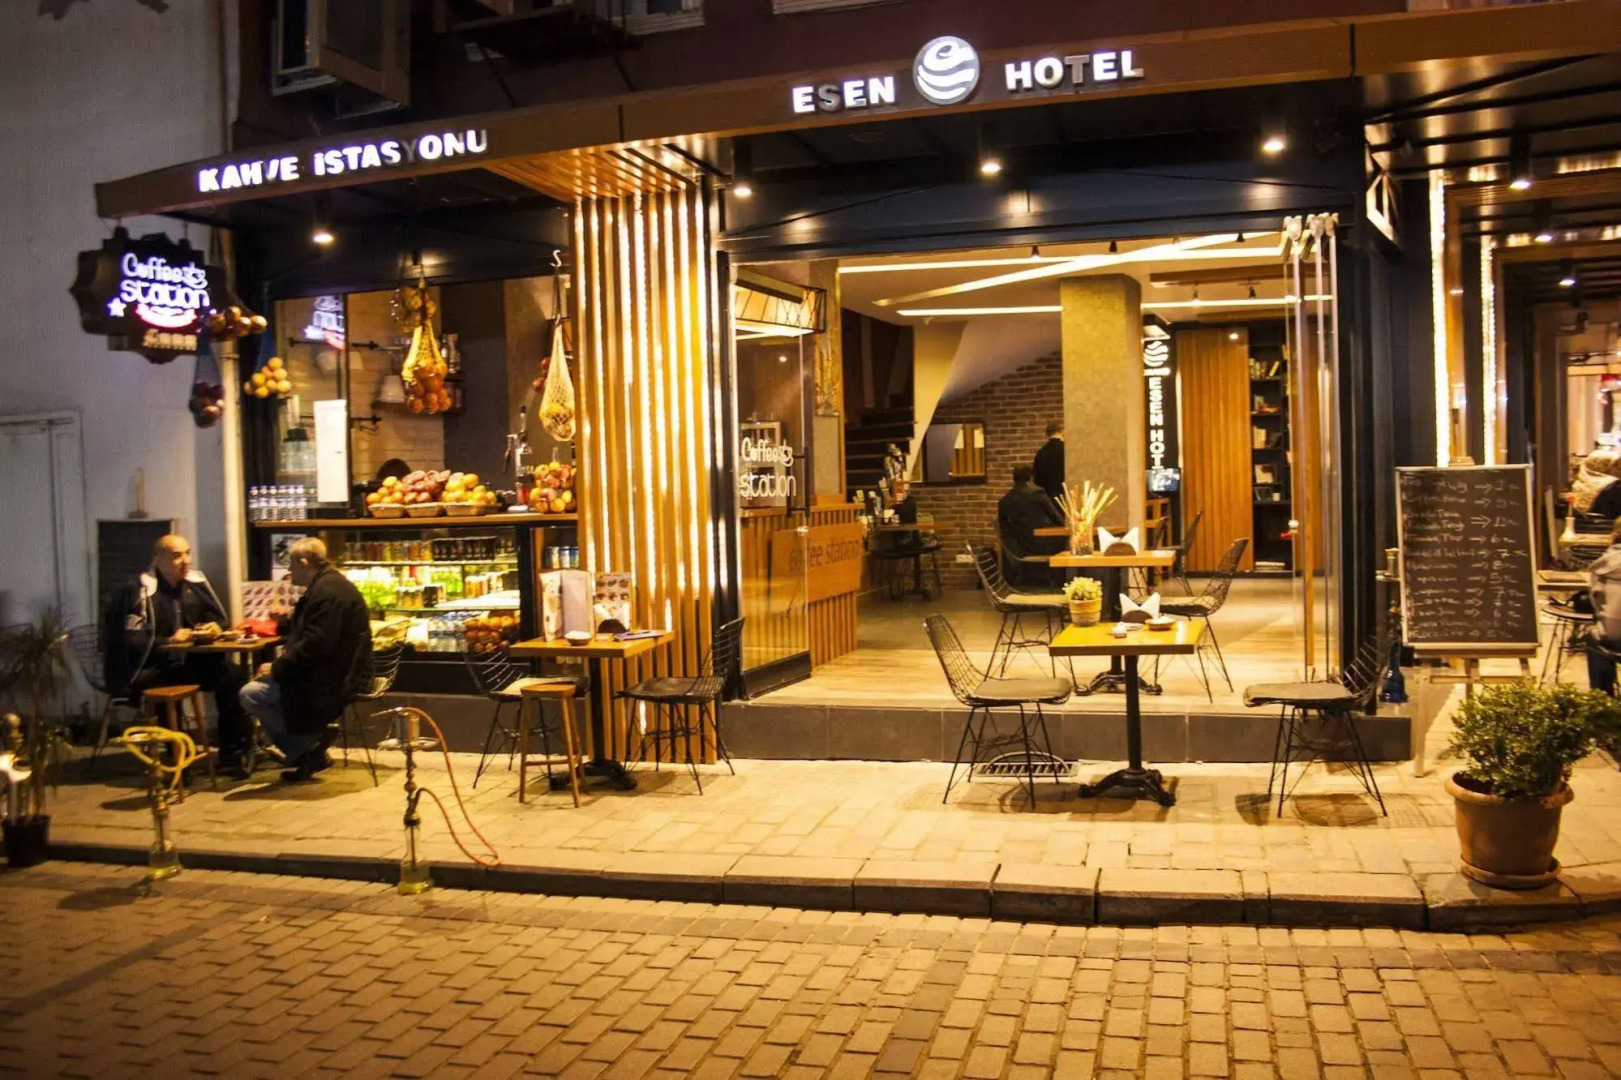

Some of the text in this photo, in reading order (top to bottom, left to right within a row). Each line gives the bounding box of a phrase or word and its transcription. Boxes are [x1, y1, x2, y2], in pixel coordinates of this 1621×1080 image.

[792, 50, 1144, 114] ESEN HOTEL
[119, 279, 211, 309] station
[1148, 376, 1166, 470] ESEN HOT
[739, 472, 797, 498] station
[789, 536, 824, 572] cofee
